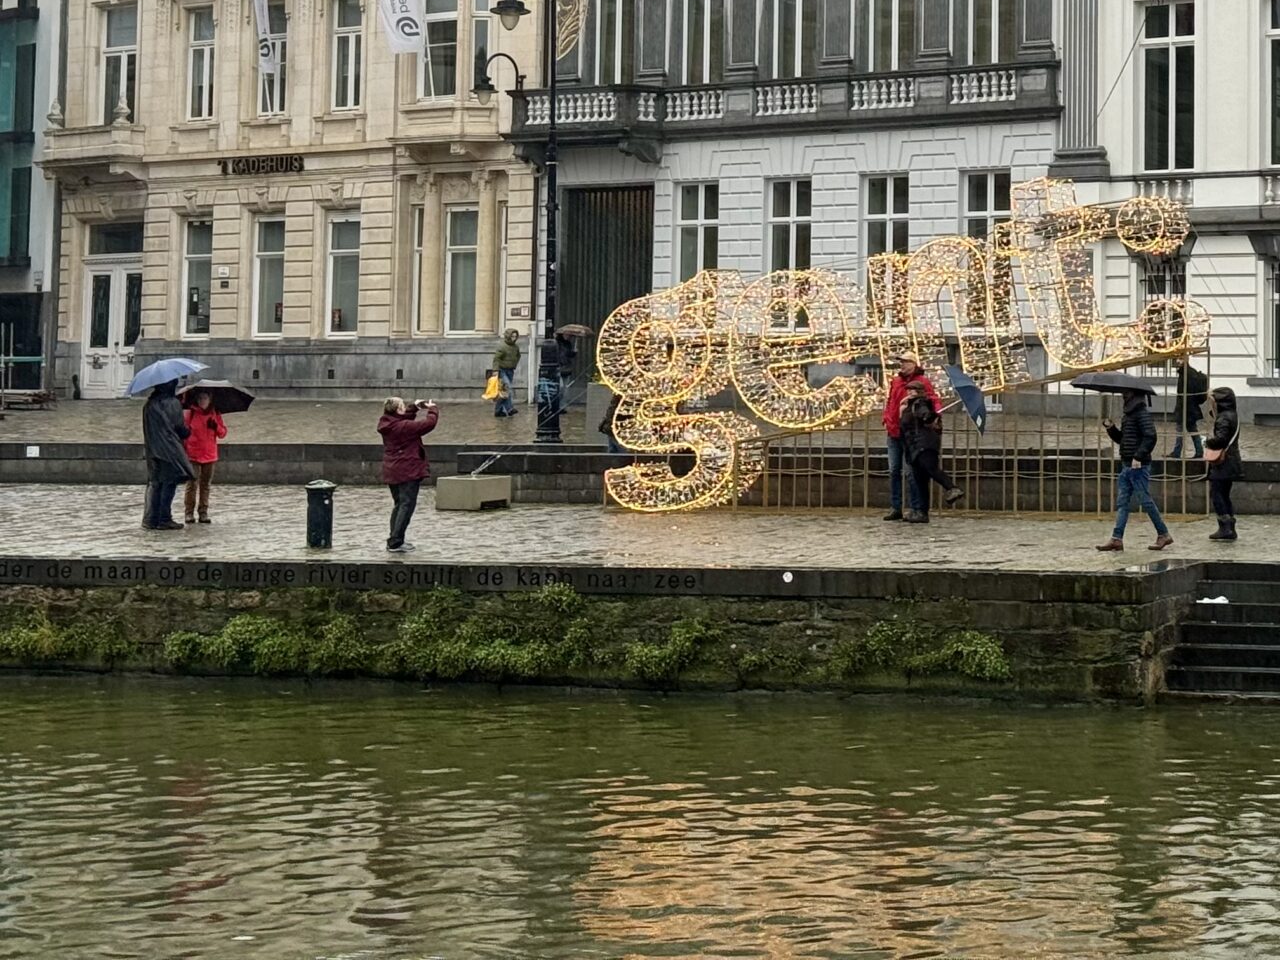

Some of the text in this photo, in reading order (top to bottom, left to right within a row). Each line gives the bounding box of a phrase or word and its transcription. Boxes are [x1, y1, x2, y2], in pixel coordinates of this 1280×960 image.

[232, 155, 303, 174] KADEHUIS
[46, 561, 72, 578] de
[84, 565, 147, 580] maan
[159, 566, 185, 584] op
[197, 565, 223, 582] de
[236, 565, 295, 585] lange
[308, 566, 371, 583] rivier
[476, 568, 504, 586] de
[587, 573, 642, 587] naar
[654, 573, 696, 589] zee
